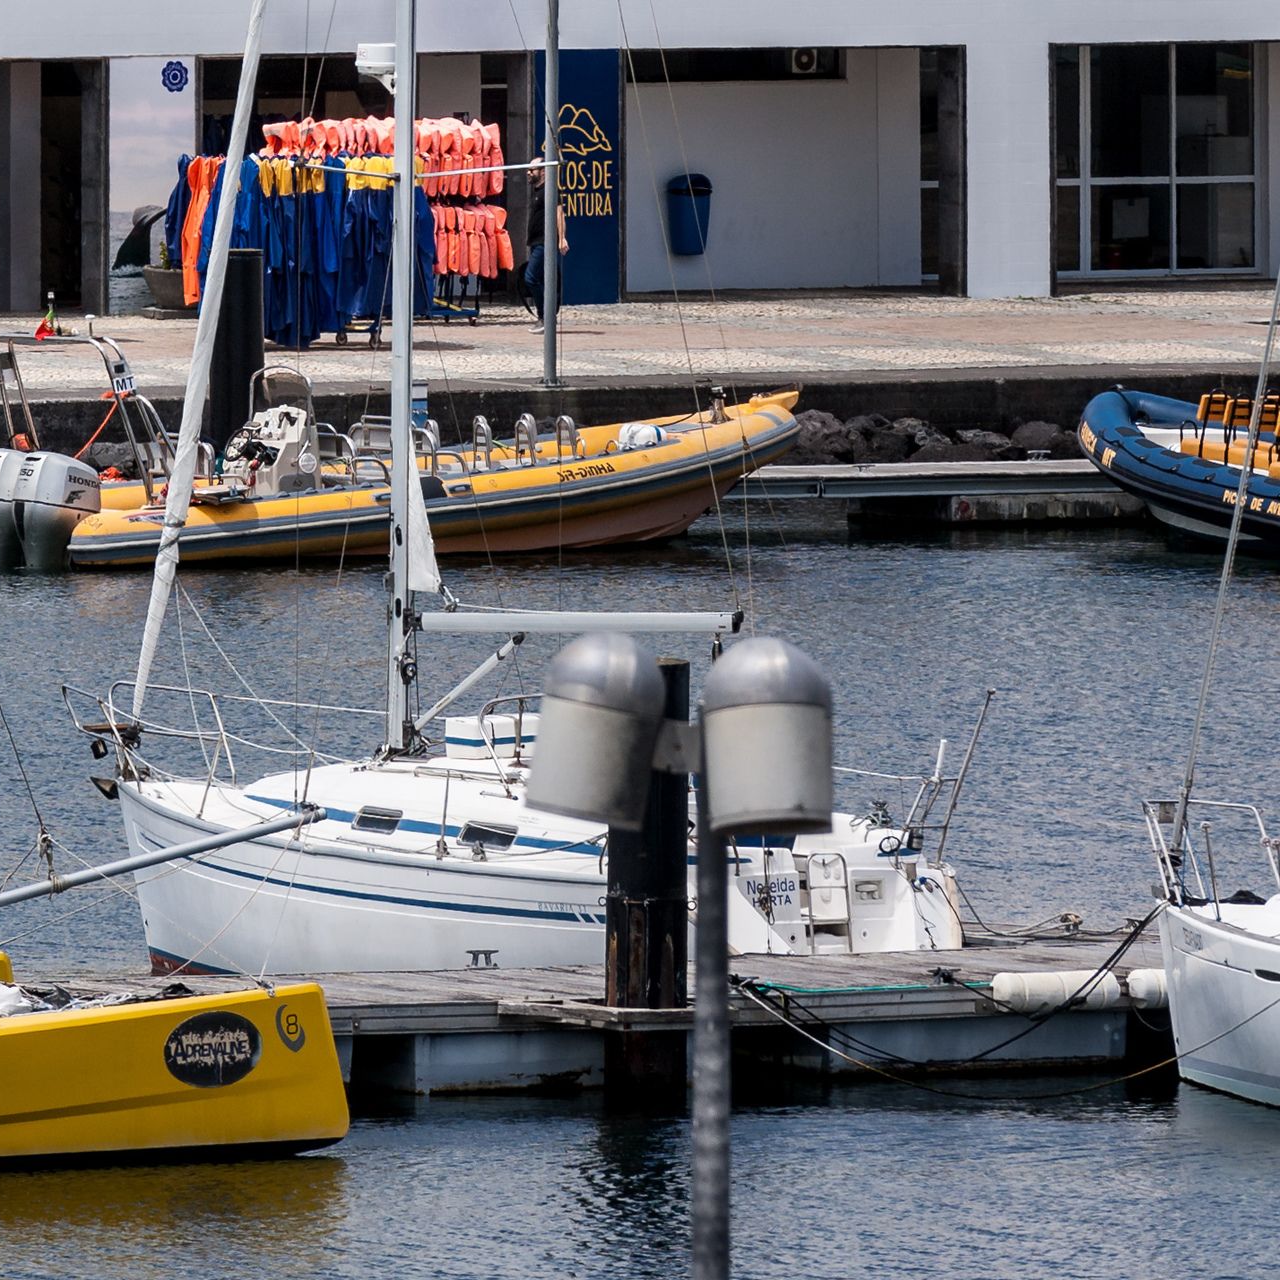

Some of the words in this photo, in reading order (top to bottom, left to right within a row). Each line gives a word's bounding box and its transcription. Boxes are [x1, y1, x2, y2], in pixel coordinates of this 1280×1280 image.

[116, 376, 134, 391] MT
[1223, 489, 1248, 507] PICS
[1250, 497, 1264, 512] DE
[746, 878, 795, 895] Neeida
[752, 894, 792, 908] HRTA
[285, 1013, 299, 1035] 8
